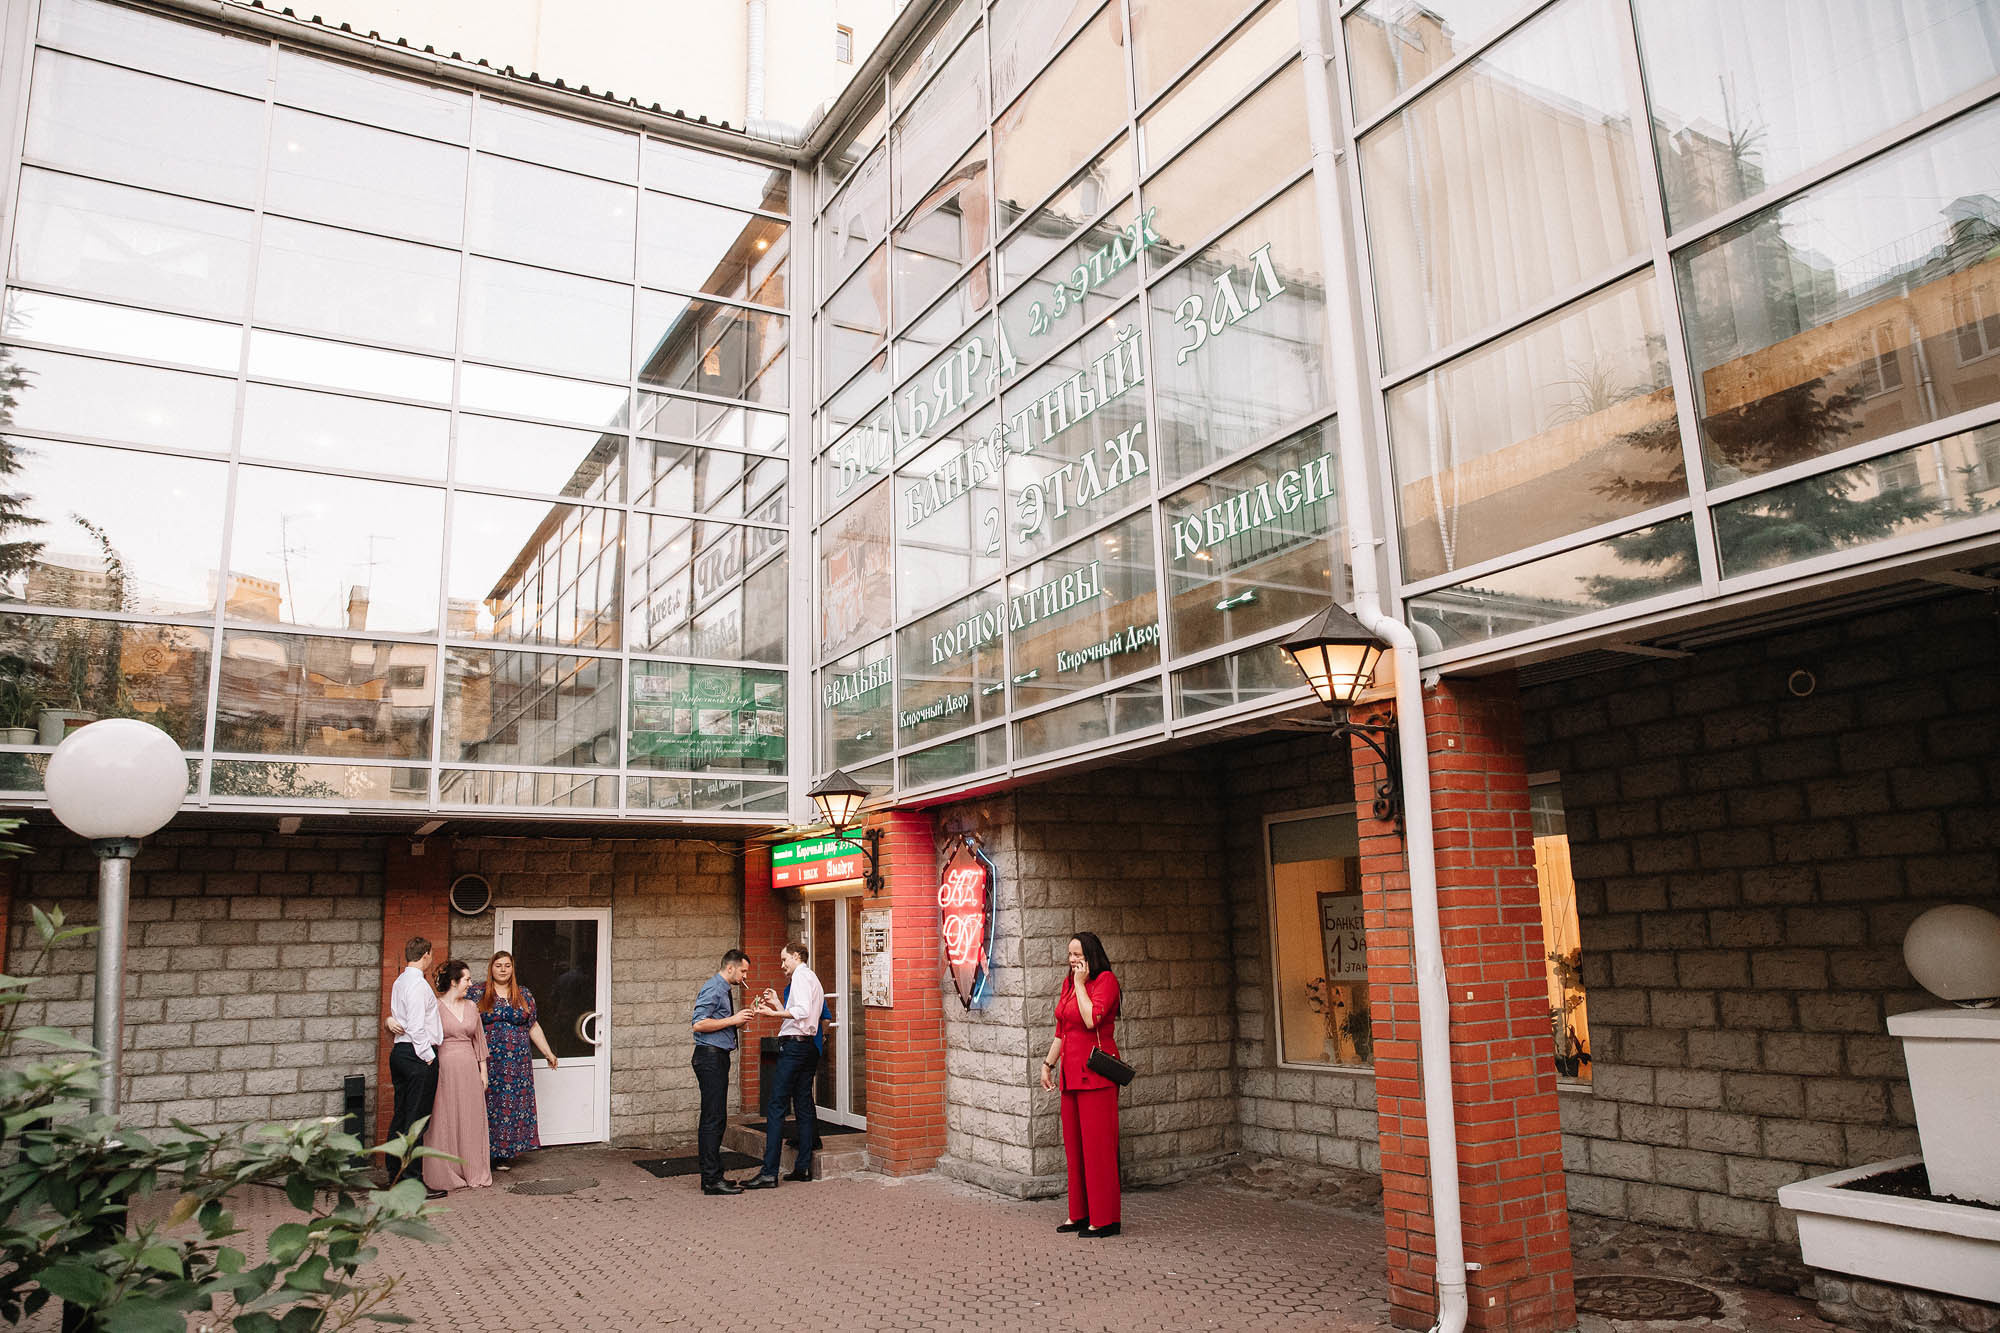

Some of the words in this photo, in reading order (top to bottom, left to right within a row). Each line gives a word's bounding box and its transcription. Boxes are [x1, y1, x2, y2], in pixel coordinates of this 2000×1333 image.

[1071, 206, 1160, 303] ЭТАЖ
[836, 316, 1017, 498] БИЛЬЯРД
[904, 324, 1145, 530] БАНКЕТНЫЙ
[1174, 242, 1287, 367] ЗАЛ
[983, 506, 1000, 557] 2
[1017, 421, 1149, 545] ЭТАЖ
[1172, 452, 1335, 561] ЮБИЛЕИ
[930, 559, 1101, 665] КОРПОРАТИВЫ
[1056, 631, 1123, 673] Кирочный
[1125, 622, 1161, 654] Двор
[822, 655, 892, 709] СВАДЬБЫ
[900, 699, 944, 729] Кирочный
[945, 693, 969, 717] Двор
[1331, 934, 1342, 973] 1
[1347, 931, 1368, 952] ЗА
